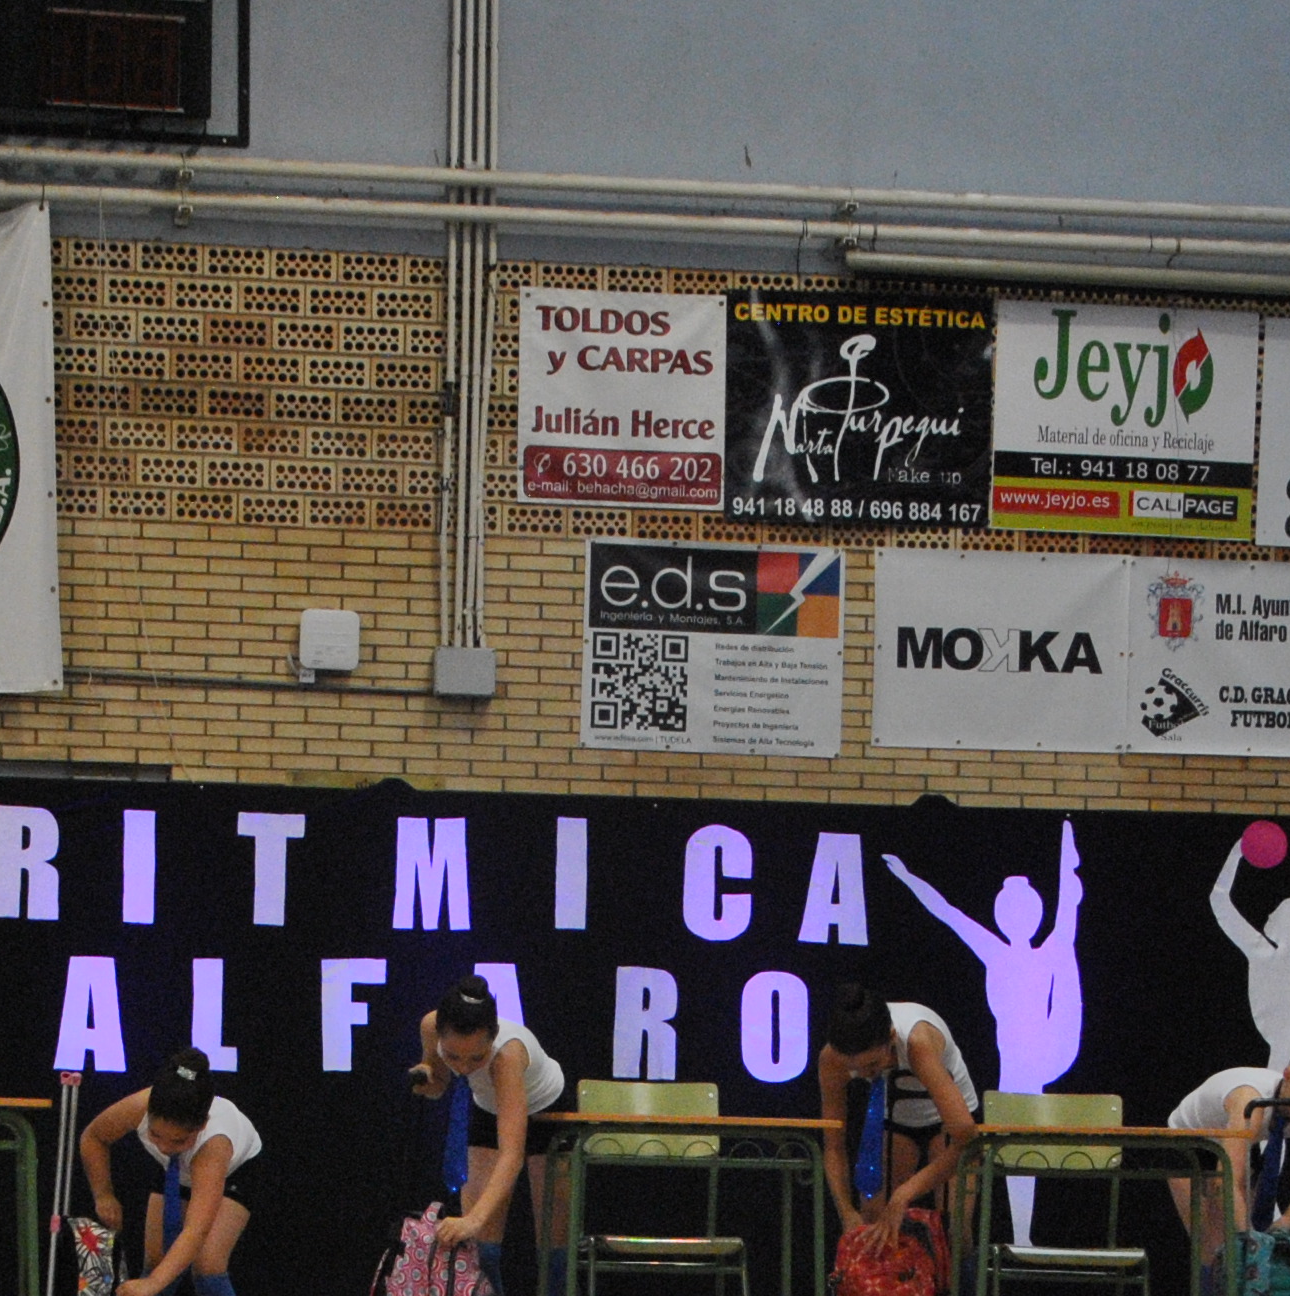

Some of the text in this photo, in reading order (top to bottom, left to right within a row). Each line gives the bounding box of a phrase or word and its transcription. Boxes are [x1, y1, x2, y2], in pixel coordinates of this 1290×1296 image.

[536, 305, 671, 336] TOLDOS
[734, 303, 986, 329] CENTRO DE ESTÉTICA
[546, 345, 714, 376] y CARPAS
[1033, 309, 1214, 427] Jeyjo
[531, 405, 715, 440] Julián Herce
[1037, 425, 1215, 454] Material de oficina y Reciclaje
[562, 452, 712, 482] 630 466 202
[1030, 458, 1209, 482] Tel.: 941 18 08 77
[527, 481, 718, 499] e-mail: behacha@gmail.com
[1000, 491, 1110, 509] www.jeyjo.es
[733, 498, 981, 522] 941 18 48 88 696 884 167
[1215, 594, 1246, 615] M.I.
[658, 614, 663, 623] y
[1215, 620, 1288, 642] de Alfaro
[1162, 668, 1209, 716] Graccurris
[1219, 686, 1247, 703] C.D.
